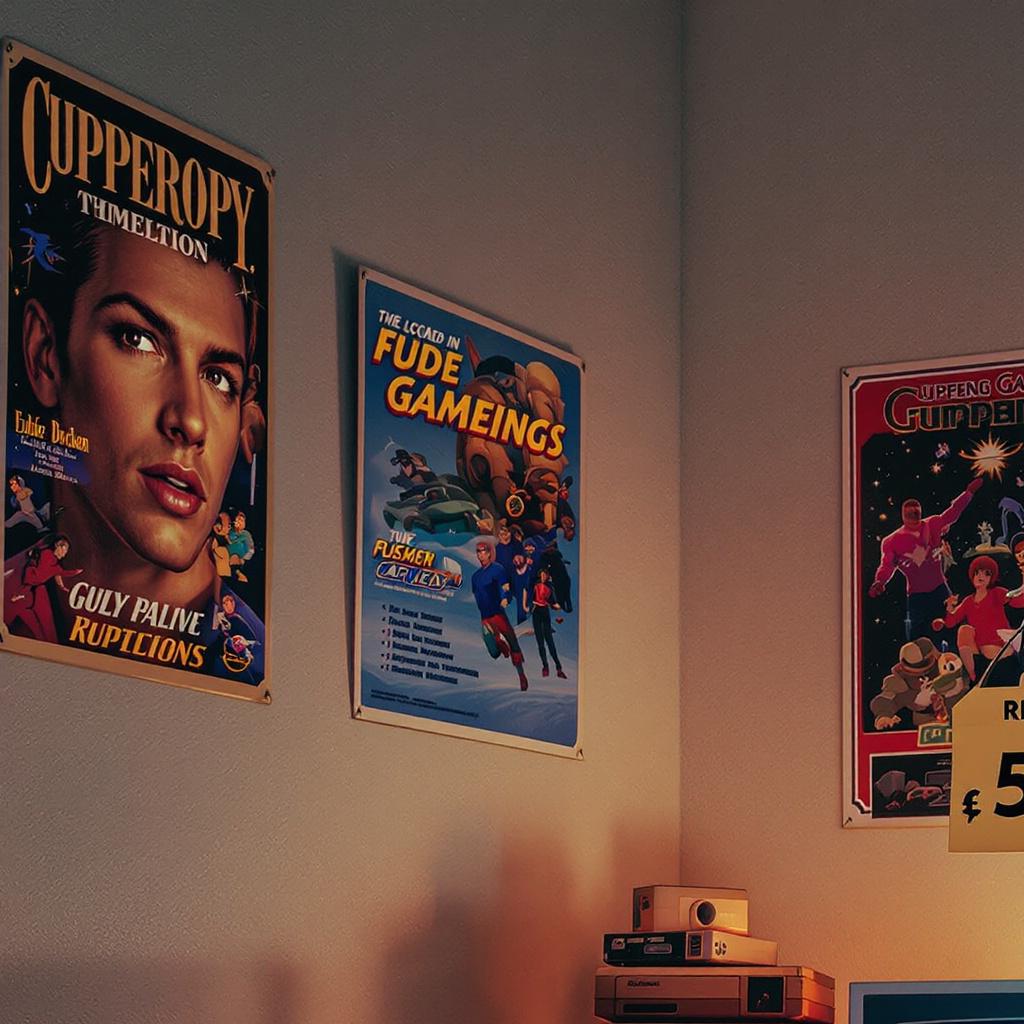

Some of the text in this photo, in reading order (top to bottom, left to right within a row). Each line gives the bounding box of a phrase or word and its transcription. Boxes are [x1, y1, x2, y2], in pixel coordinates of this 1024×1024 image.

[22, 76, 255, 272] CUPPEROPY
[77, 189, 209, 263] THIMELTION
[371, 327, 464, 388] FUDE
[446, 335, 461, 350] IN
[385, 376, 567, 461] GAMEINGS
[68, 582, 205, 636] GULY PALIVE
